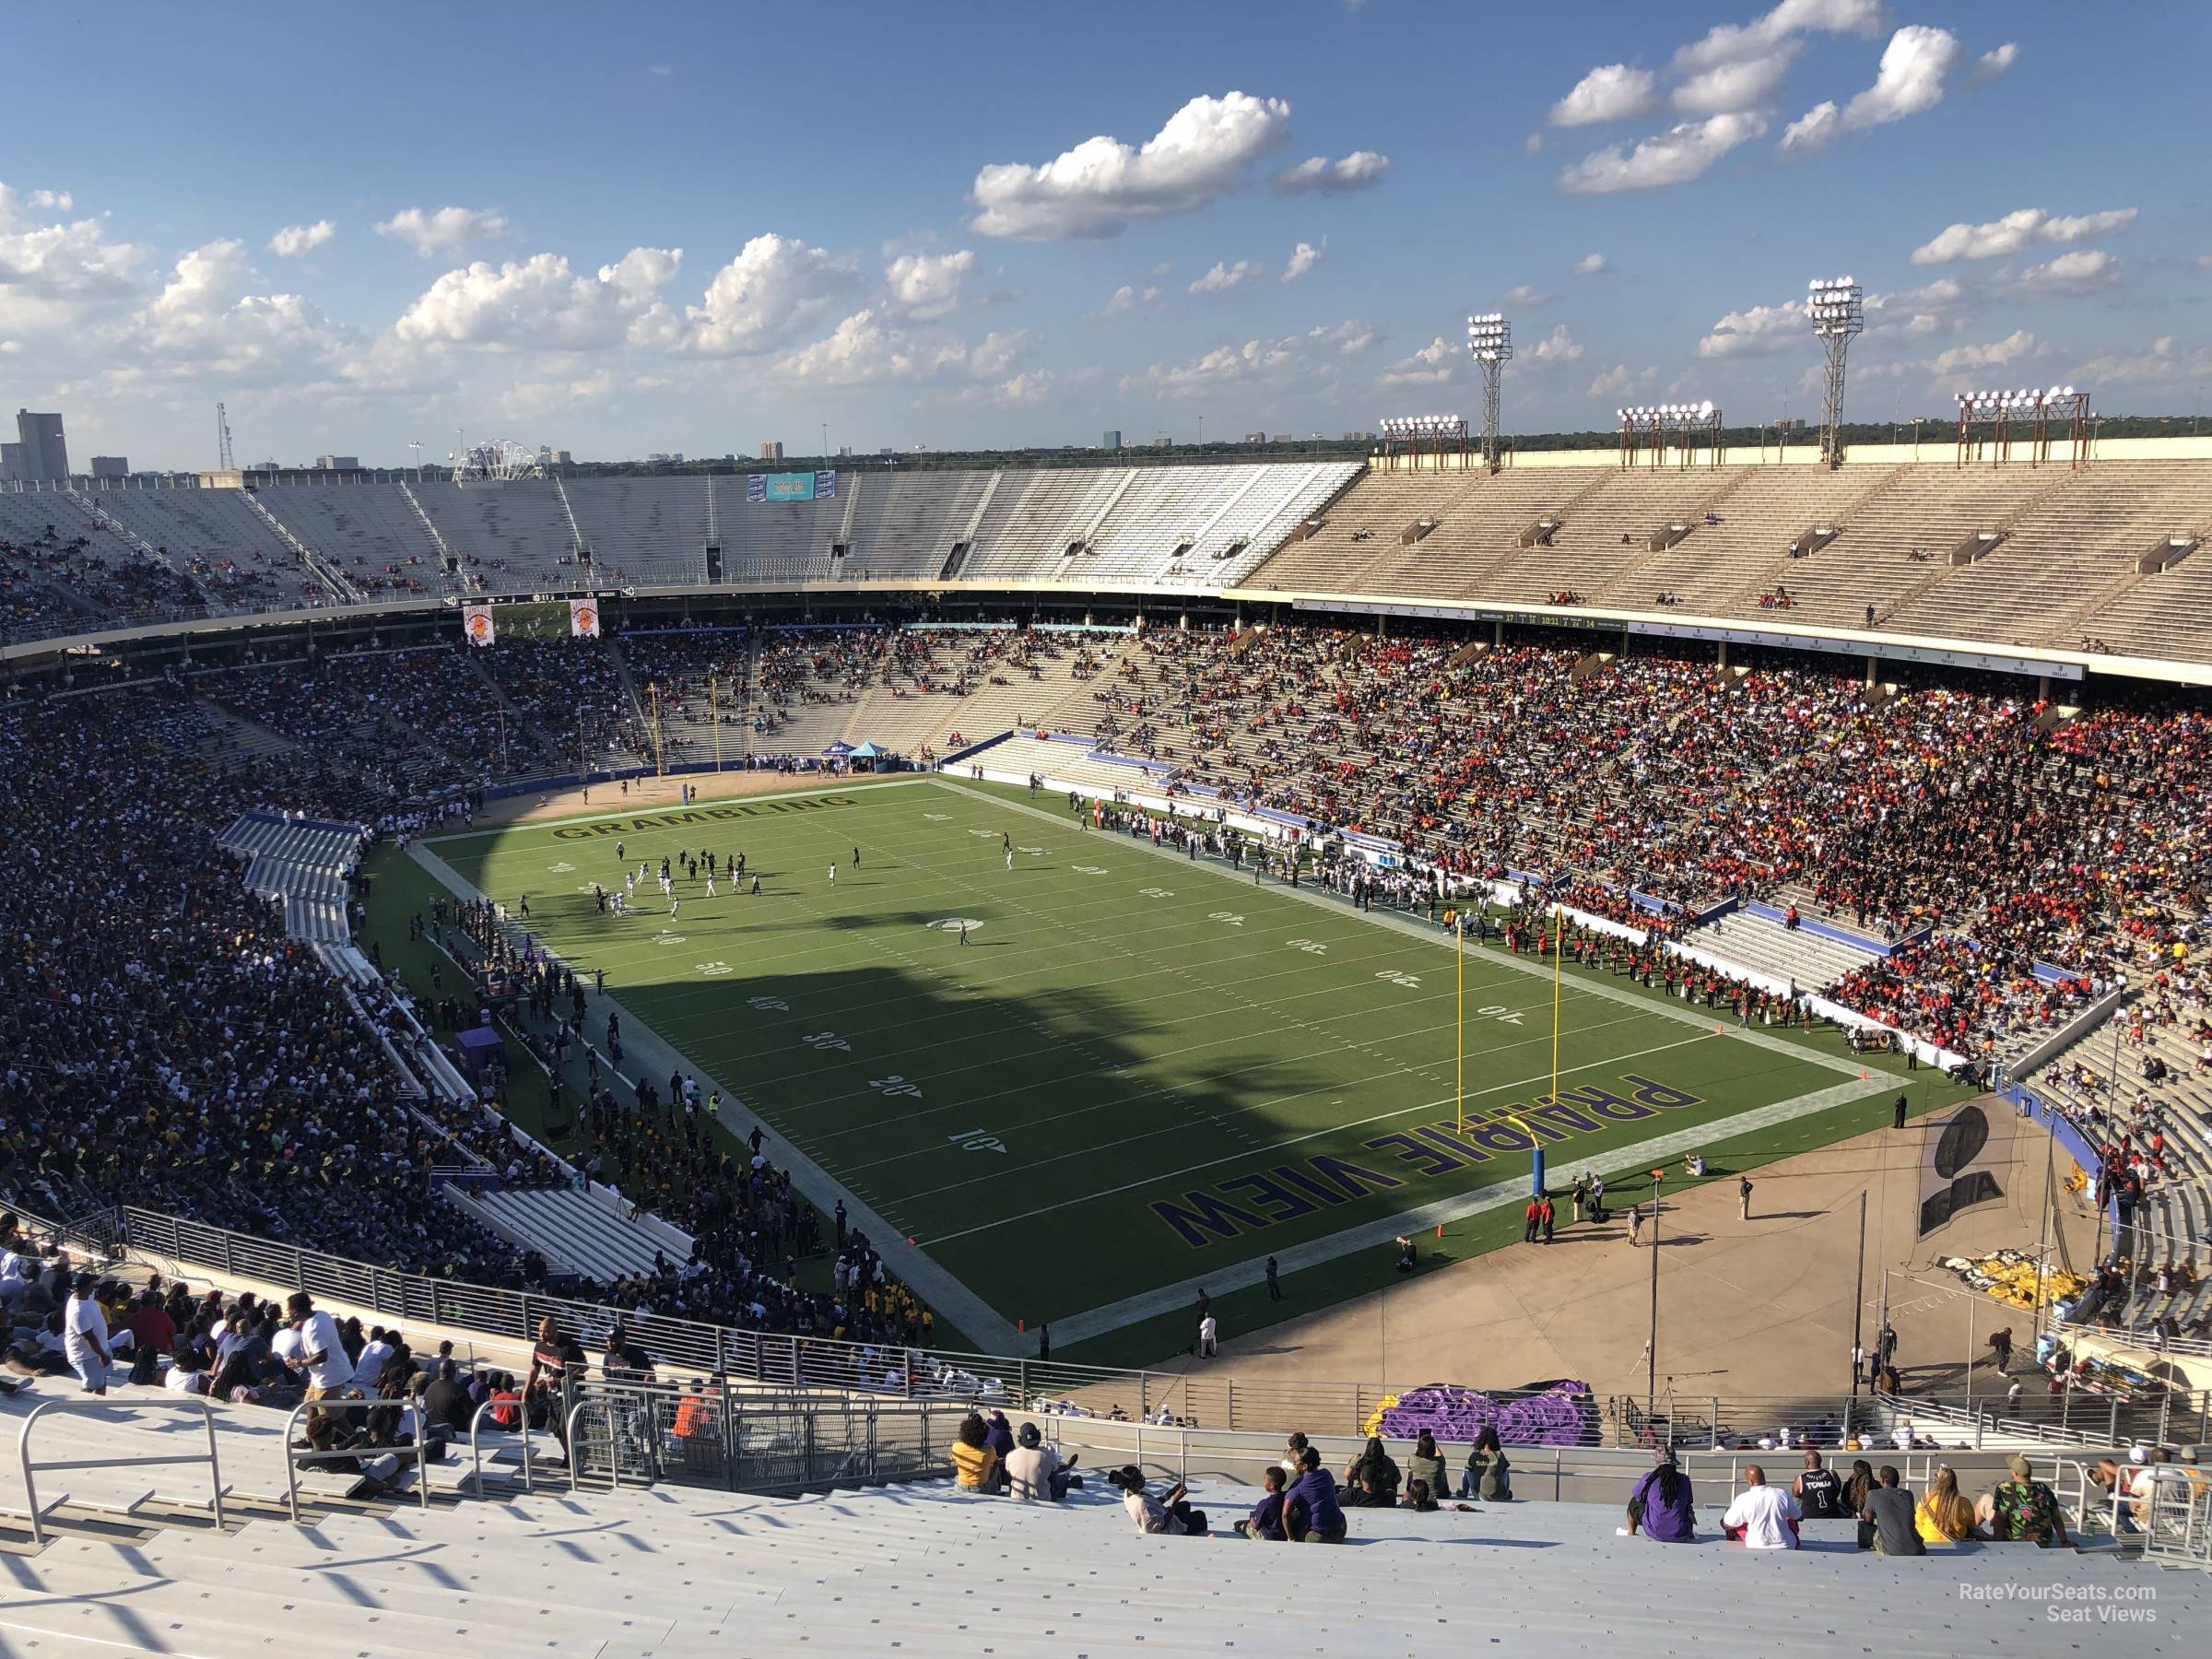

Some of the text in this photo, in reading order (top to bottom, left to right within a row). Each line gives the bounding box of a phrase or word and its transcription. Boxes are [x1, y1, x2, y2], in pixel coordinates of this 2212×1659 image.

[621, 587, 634, 595] 40
[443, 596, 457, 606] 40
[1506, 614, 1513, 622] 17
[1542, 617, 1559, 625] 10:11
[553, 796, 859, 840] GRAMBLING
[1374, 970, 1422, 986] 20
[745, 995, 785, 1010] 40
[1477, 1006, 1526, 1021] 10
[802, 1031, 847, 1050] 30
[867, 1075, 917, 1096] 20
[947, 1128, 1000, 1151] 10
[1147, 1074, 1708, 1250] PRAIRIE VIEW
[1817, 1490, 1828, 1509] 1
